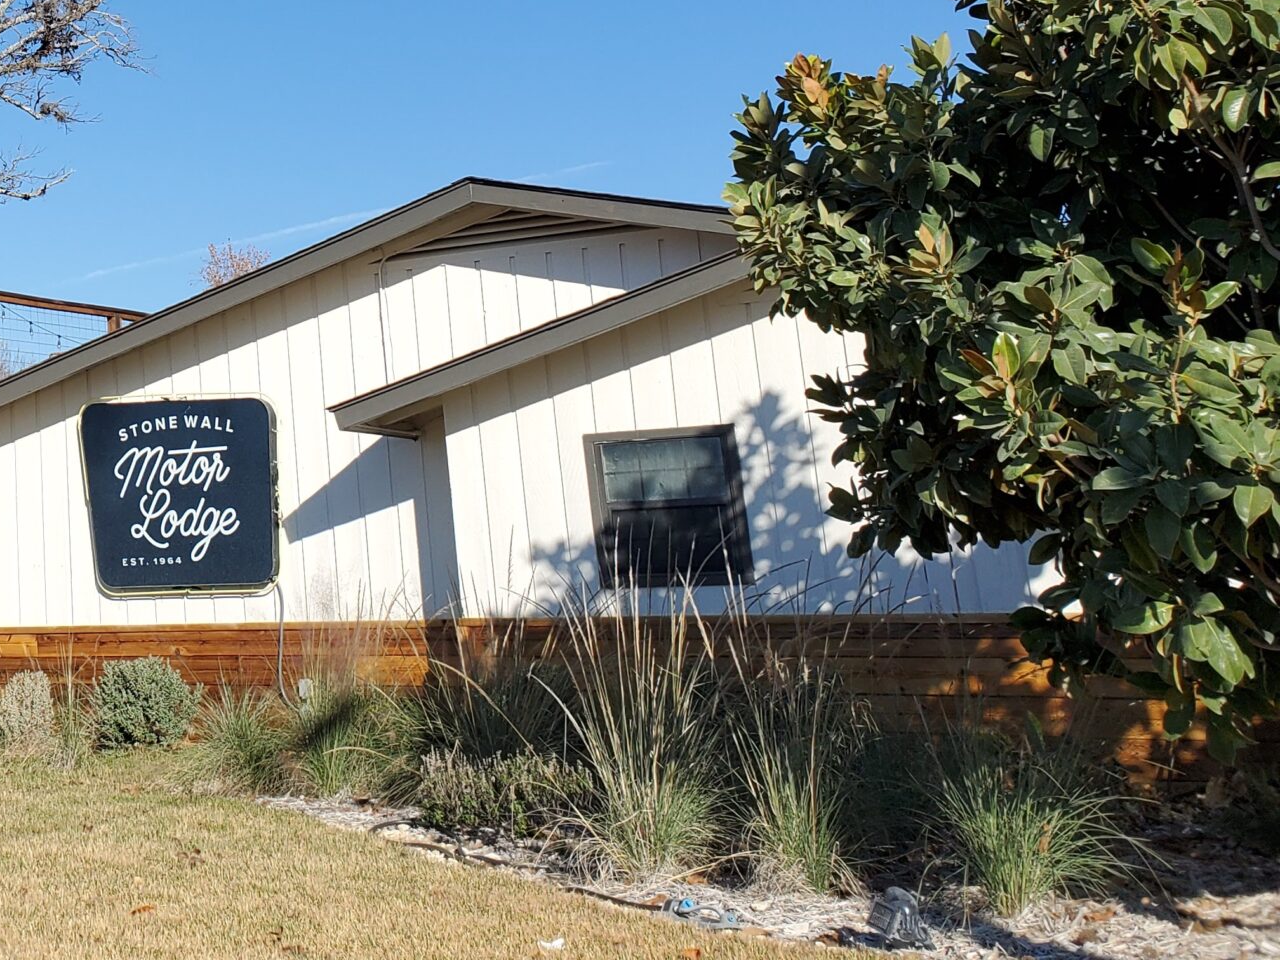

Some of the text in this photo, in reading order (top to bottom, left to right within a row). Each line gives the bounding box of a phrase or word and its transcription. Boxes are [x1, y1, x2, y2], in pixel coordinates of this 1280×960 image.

[118, 414, 234, 442] STONE WALL
[113, 439, 231, 499] Motor
[130, 488, 241, 562] Lodge
[122, 556, 182, 567] EST. 1964
